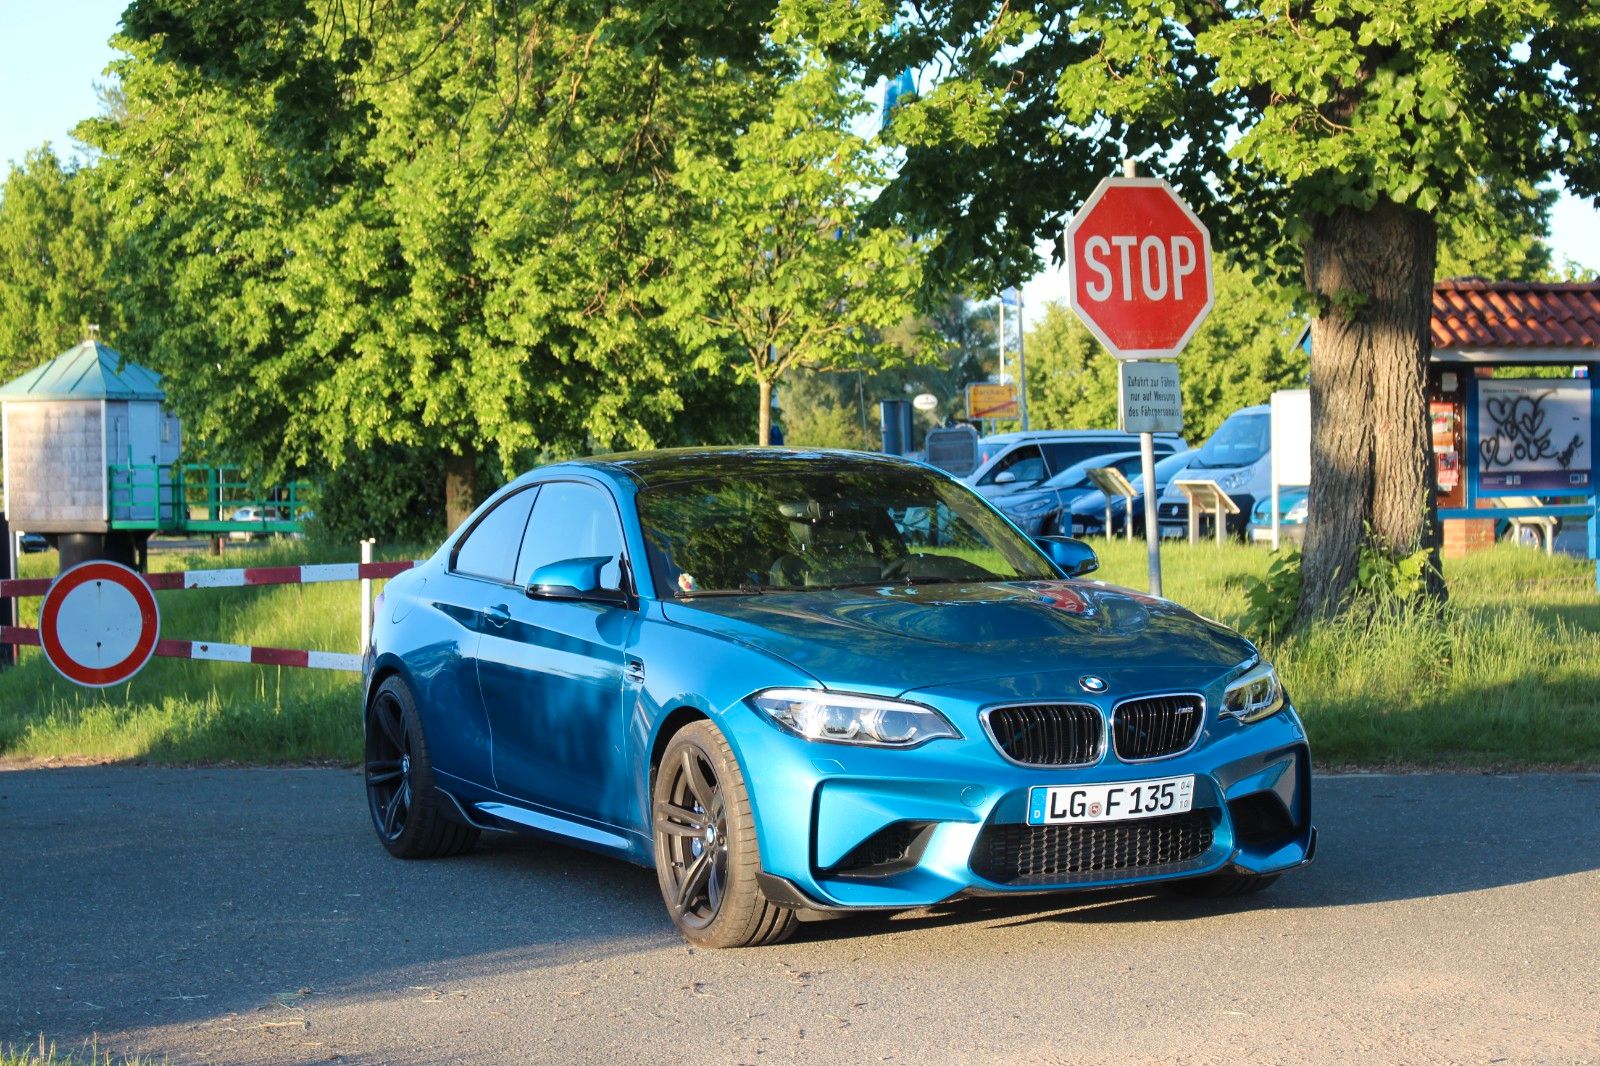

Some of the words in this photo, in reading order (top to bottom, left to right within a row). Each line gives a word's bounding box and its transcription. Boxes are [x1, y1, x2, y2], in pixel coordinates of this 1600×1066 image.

[1084, 235, 1196, 301] STOP
[1127, 376, 1149, 387] Zufahrt
[1150, 379, 1159, 387] zur
[1160, 376, 1176, 387] Fähre
[1130, 393, 1140, 401] nur
[1142, 391, 1152, 401] auf
[1153, 391, 1176, 404] Weisung
[1128, 406, 1139, 417] des
[1050, 790, 1087, 819] LG
[1105, 788, 1124, 816] F
[1128, 782, 1176, 814] 135
[1033, 809, 1041, 819] D
